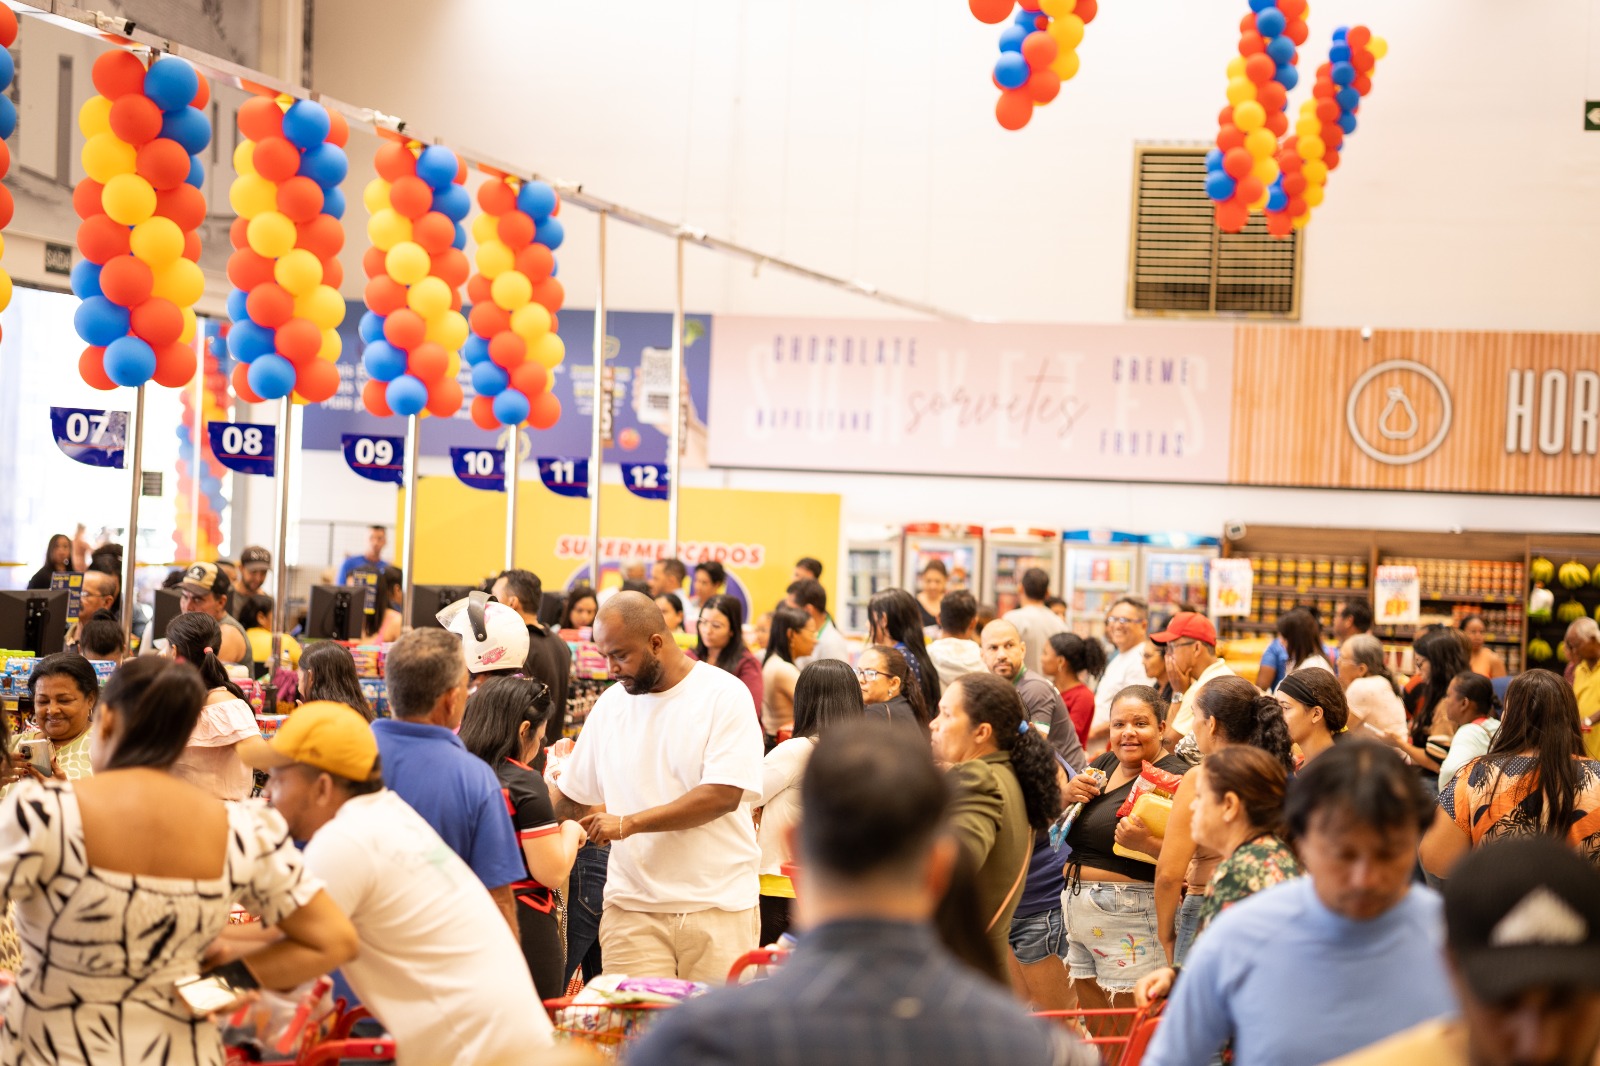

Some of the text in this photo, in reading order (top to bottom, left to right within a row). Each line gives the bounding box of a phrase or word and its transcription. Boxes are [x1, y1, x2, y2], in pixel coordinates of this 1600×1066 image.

[773, 334, 917, 367] CHOCOLATE
[1112, 355, 1190, 385] CREME
[904, 356, 1090, 439] sorvetes
[1505, 369, 1600, 456] HOR
[65, 412, 110, 445] 07
[755, 407, 872, 432] NAPOLITANO
[221, 425, 263, 456] 08
[354, 437, 394, 467] 09
[1099, 428, 1186, 458] FRUTAS
[462, 449, 495, 476] 10
[549, 460, 575, 485] 11
[629, 465, 659, 489] 12
[559, 538, 761, 564] SUERMECADOS
